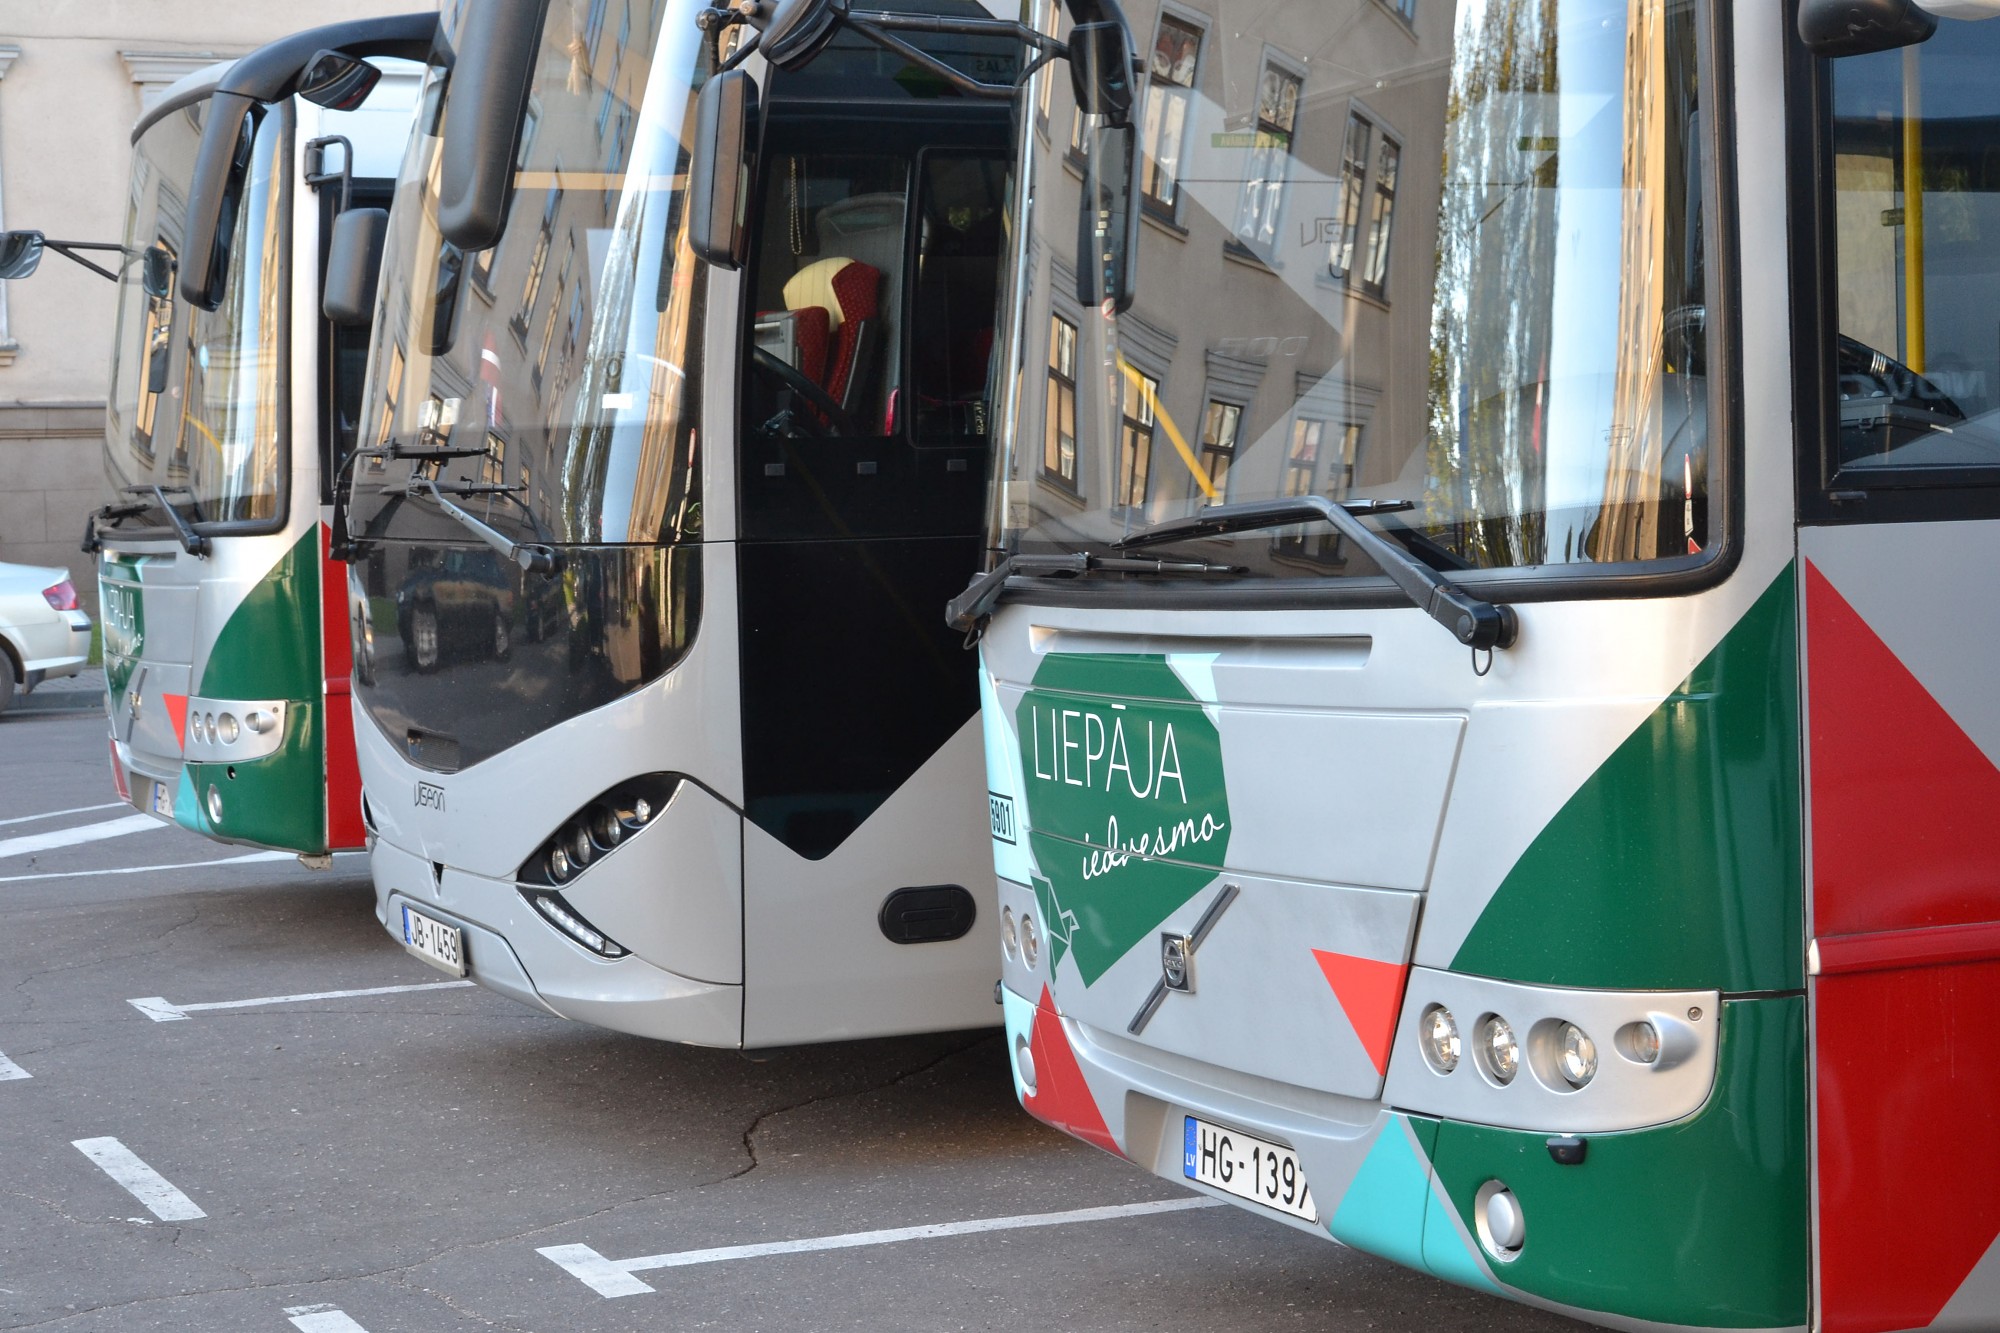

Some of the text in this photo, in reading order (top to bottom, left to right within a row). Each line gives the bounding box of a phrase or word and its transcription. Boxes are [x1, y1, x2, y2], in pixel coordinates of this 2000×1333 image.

[1033, 703, 1188, 804] LIEPĀJA
[1082, 812, 1226, 881] iedvesma
[411, 914, 458, 965] JB-1459
[1185, 1152, 1196, 1167] LV
